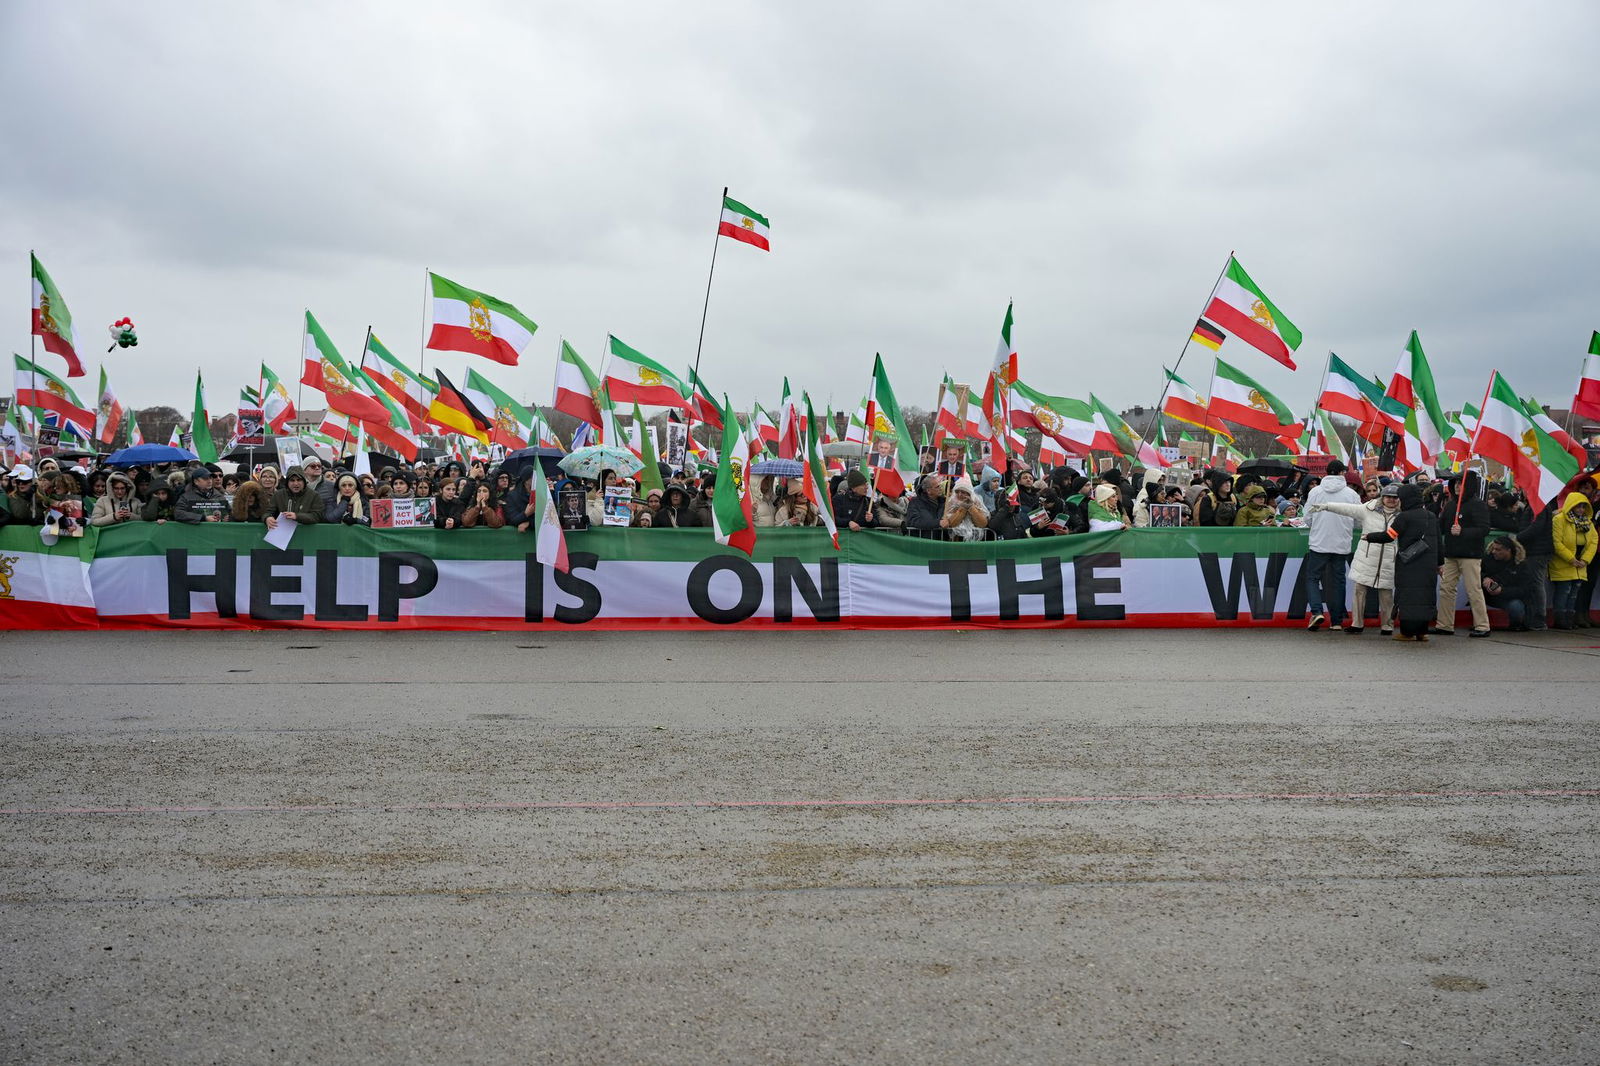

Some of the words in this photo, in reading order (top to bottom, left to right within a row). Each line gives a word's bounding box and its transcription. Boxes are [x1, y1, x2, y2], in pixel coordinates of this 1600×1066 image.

[166, 548, 439, 622] HELP
[525, 551, 602, 624] IS
[687, 555, 841, 625] ON
[928, 552, 1126, 621] THE
